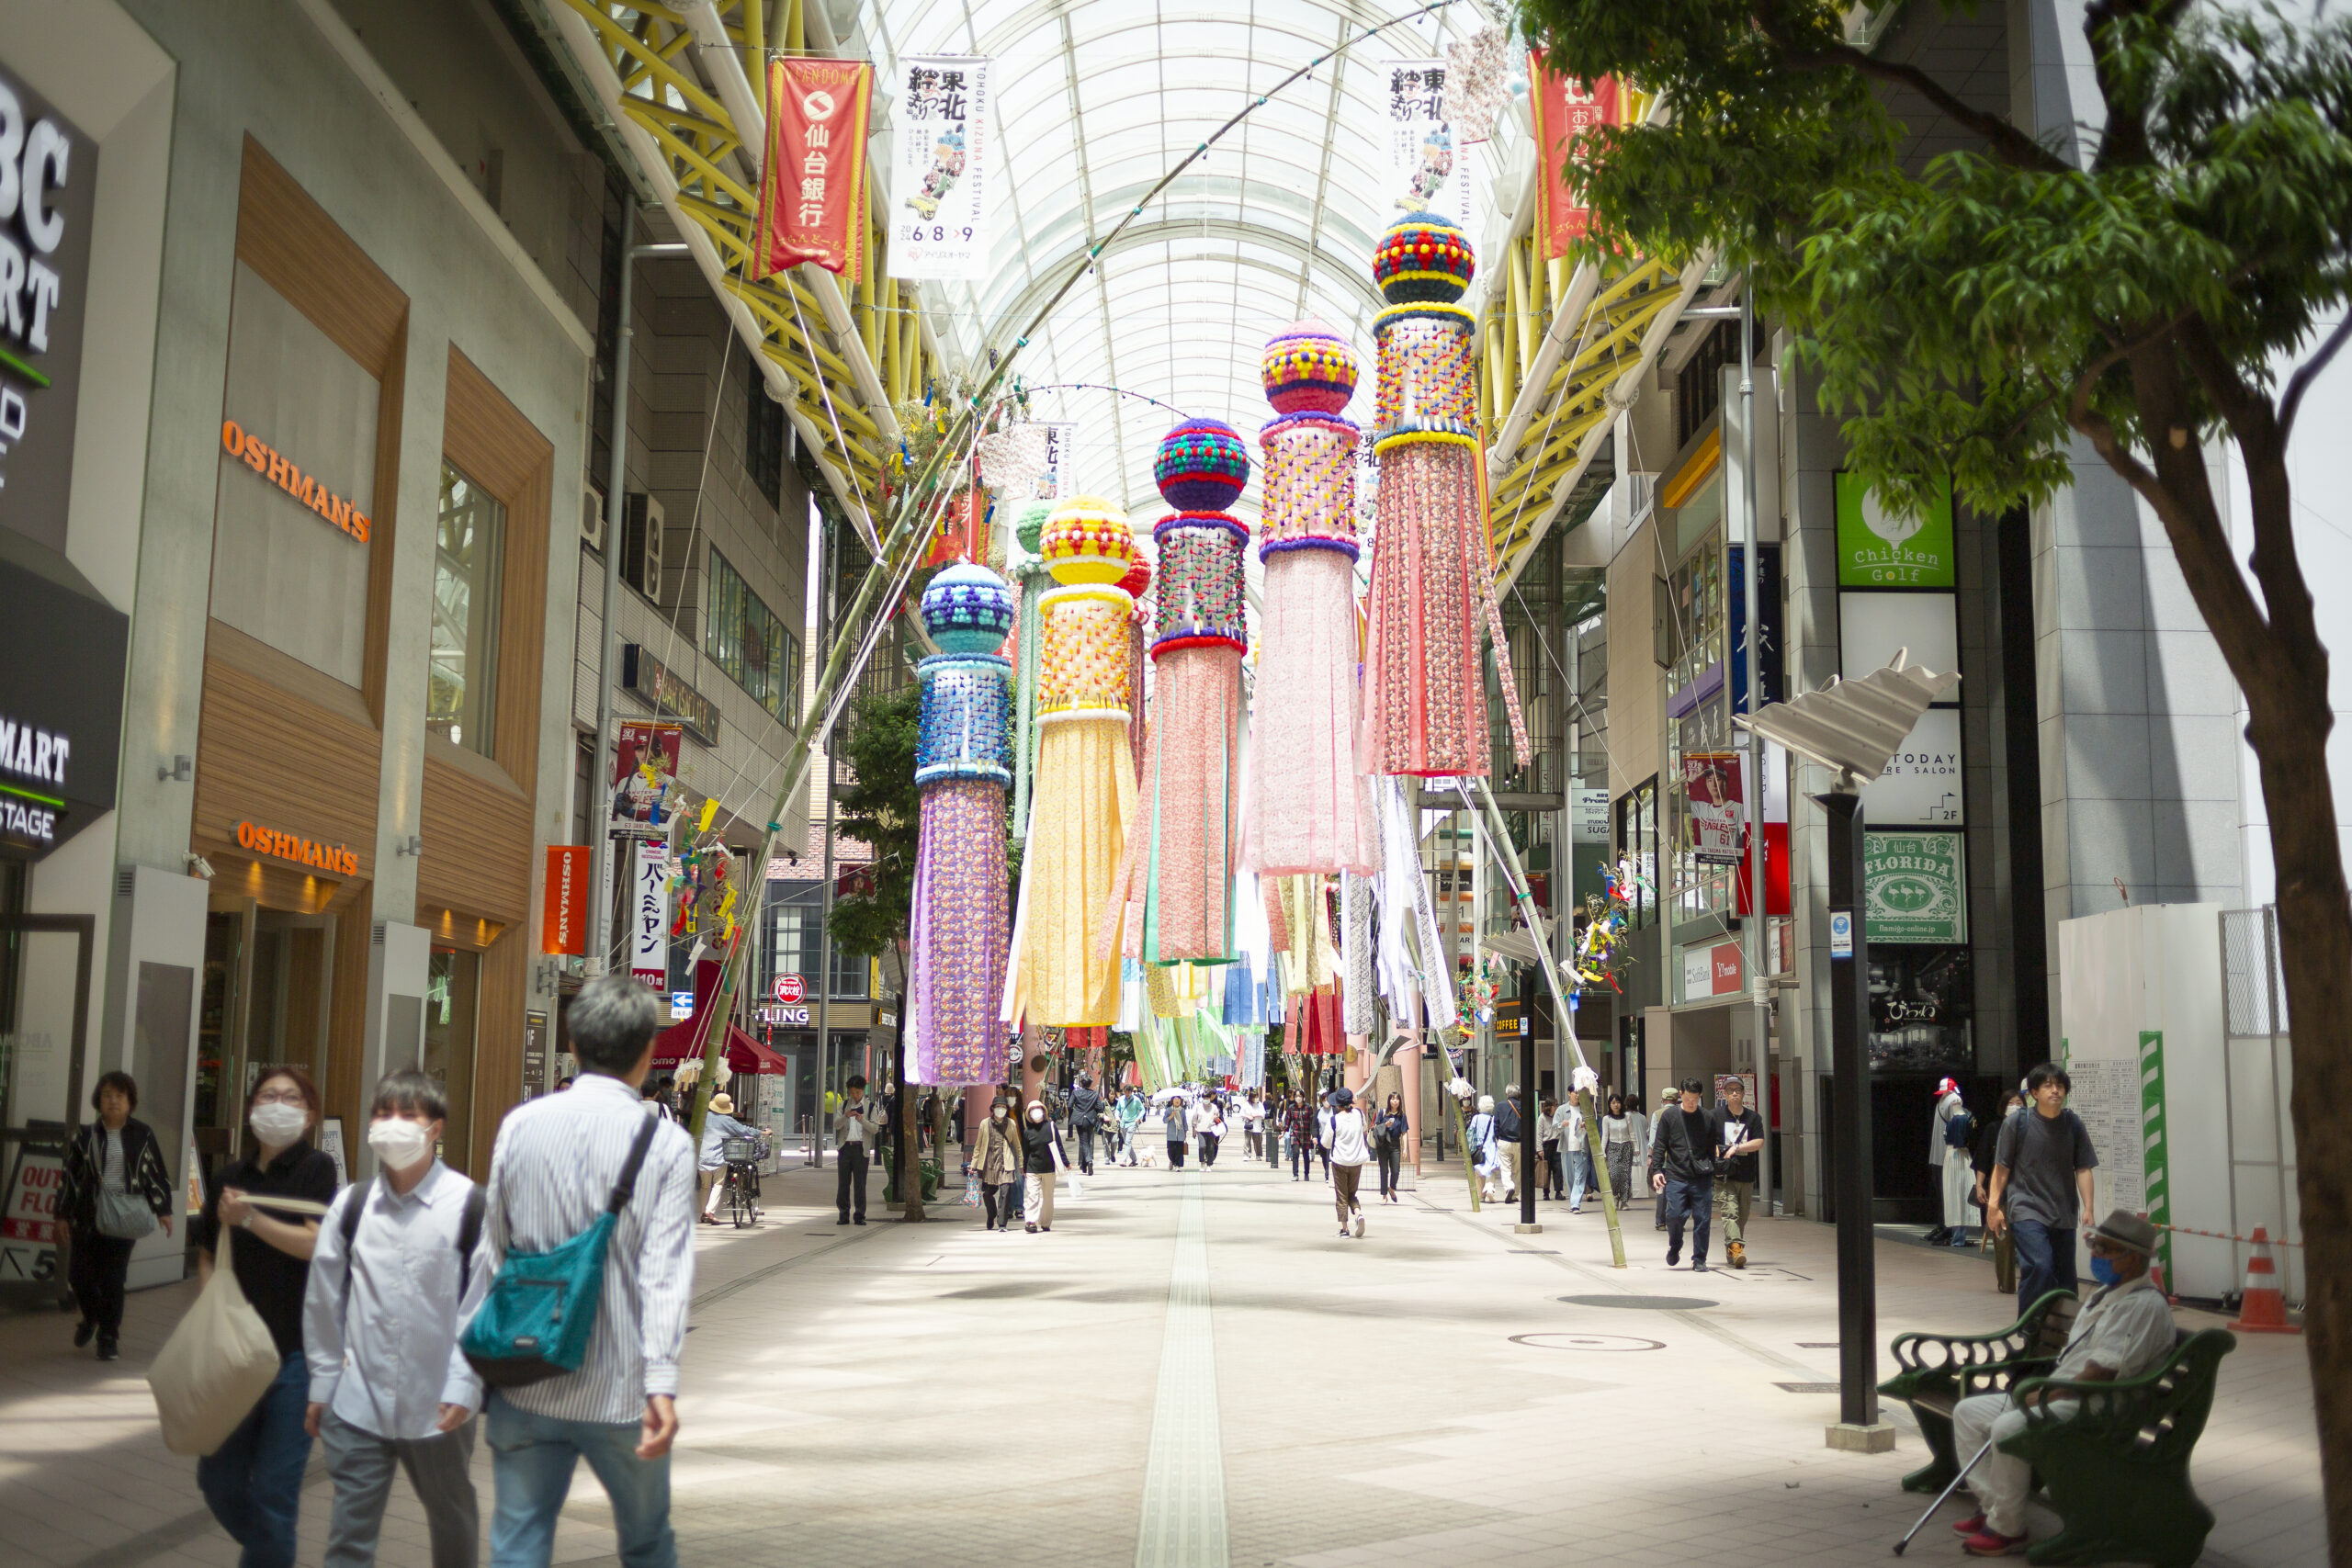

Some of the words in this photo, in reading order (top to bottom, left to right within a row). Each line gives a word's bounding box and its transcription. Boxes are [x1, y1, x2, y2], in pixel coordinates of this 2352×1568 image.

[938, 69, 968, 121] 東北
[976, 67, 986, 112] TOHOKU
[975, 119, 984, 160] KIZUNA
[798, 124, 830, 227] 仙台銀行
[972, 168, 982, 221] FESTIVAL
[1460, 167, 1470, 221] FESTIVAL
[222, 420, 370, 544] OSHMAN'S
[1854, 547, 1939, 565] Chicken
[1871, 568, 1920, 581] Golf
[1914, 766, 1956, 774] SALON
[1943, 810, 1957, 820] 2F
[238, 821, 358, 876] OSHMAN'S
[1893, 841, 1917, 854] 仙台
[559, 852, 571, 946] OSHMAN'S
[640, 863, 665, 953] バーミヤン
[779, 985, 800, 996] 消火栓
[1691, 965, 1712, 984] SoftBank
[1716, 962, 1736, 978] Y!mobile
[1496, 1019, 1518, 1031] COFFEE
